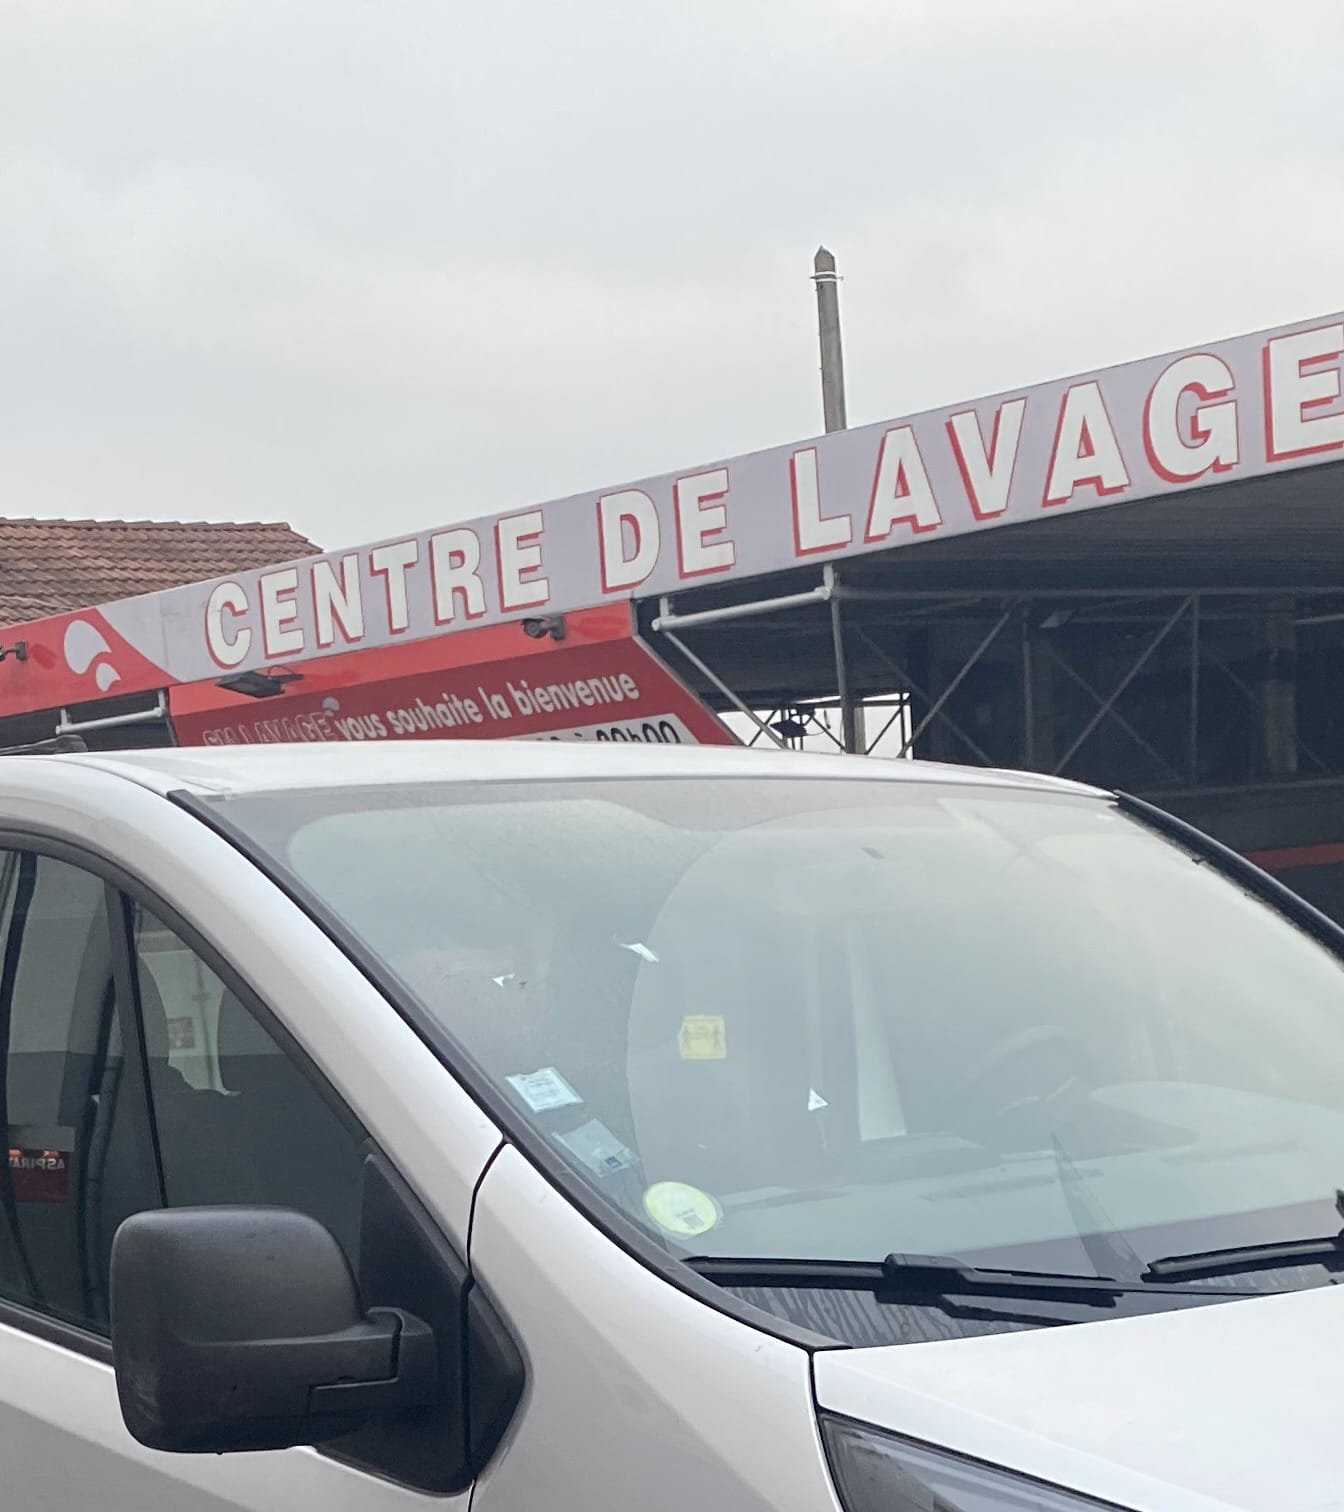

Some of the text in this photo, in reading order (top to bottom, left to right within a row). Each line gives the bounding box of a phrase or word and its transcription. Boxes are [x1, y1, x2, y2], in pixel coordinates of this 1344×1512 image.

[203, 507, 550, 670] CENTRE
[596, 466, 736, 594] DE
[335, 713, 388, 741] vous
[387, 690, 483, 735] souhaite
[480, 688, 512, 720] la
[516, 670, 640, 716] bienvenue
